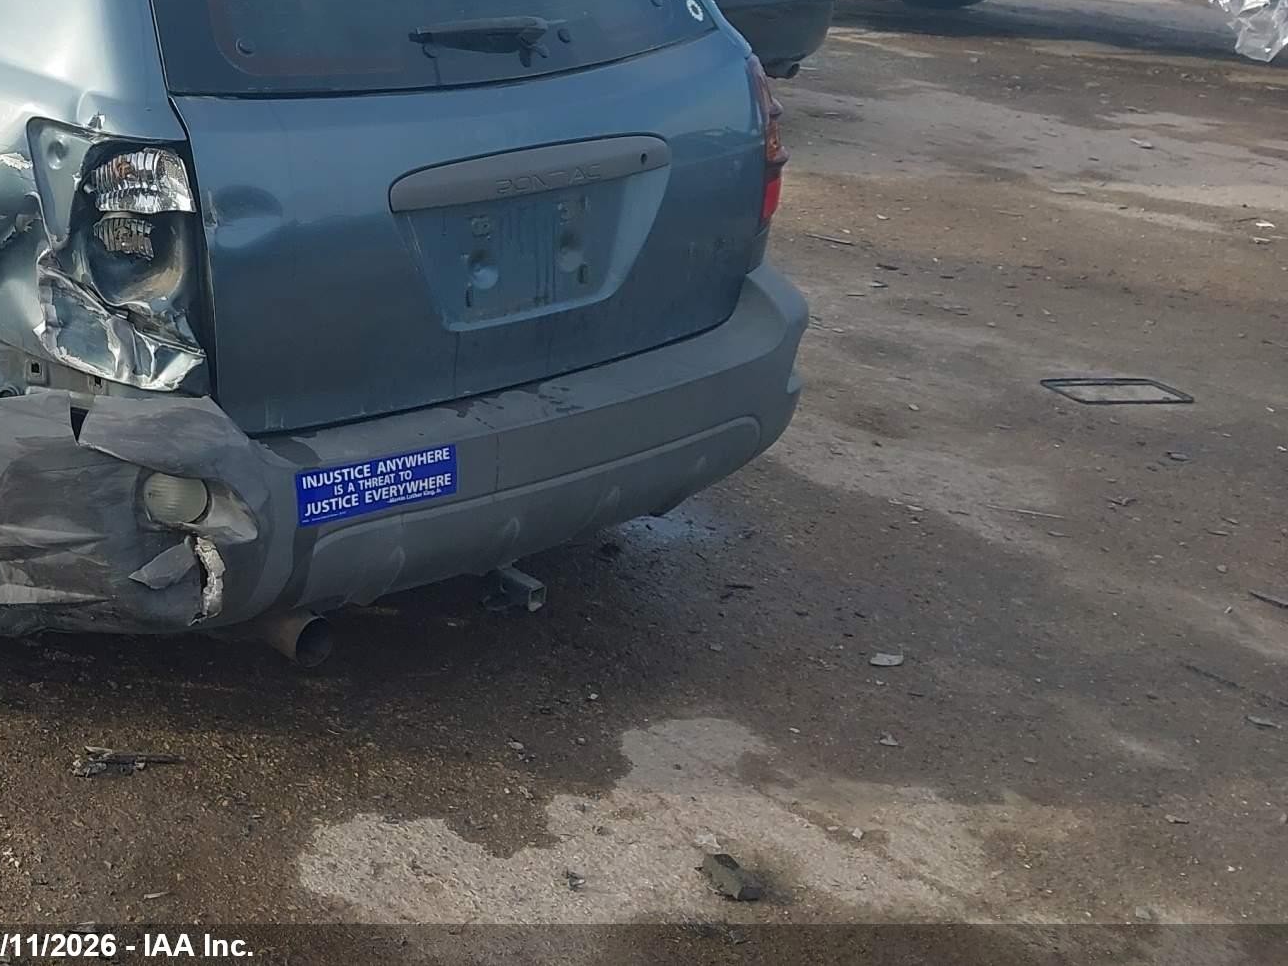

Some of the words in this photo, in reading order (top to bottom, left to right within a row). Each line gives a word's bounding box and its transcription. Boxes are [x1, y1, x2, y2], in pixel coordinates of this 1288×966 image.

[495, 163, 601, 195] PONTAC
[302, 464, 371, 490] INJUSTICE
[377, 447, 451, 475] ANYWHERE
[334, 483, 344, 496] IS
[347, 482, 355, 493] A
[358, 474, 395, 491] THREAT
[398, 470, 413, 481] TO
[304, 493, 359, 517] JUSTICE
[365, 473, 452, 504] EVERYWHERE
